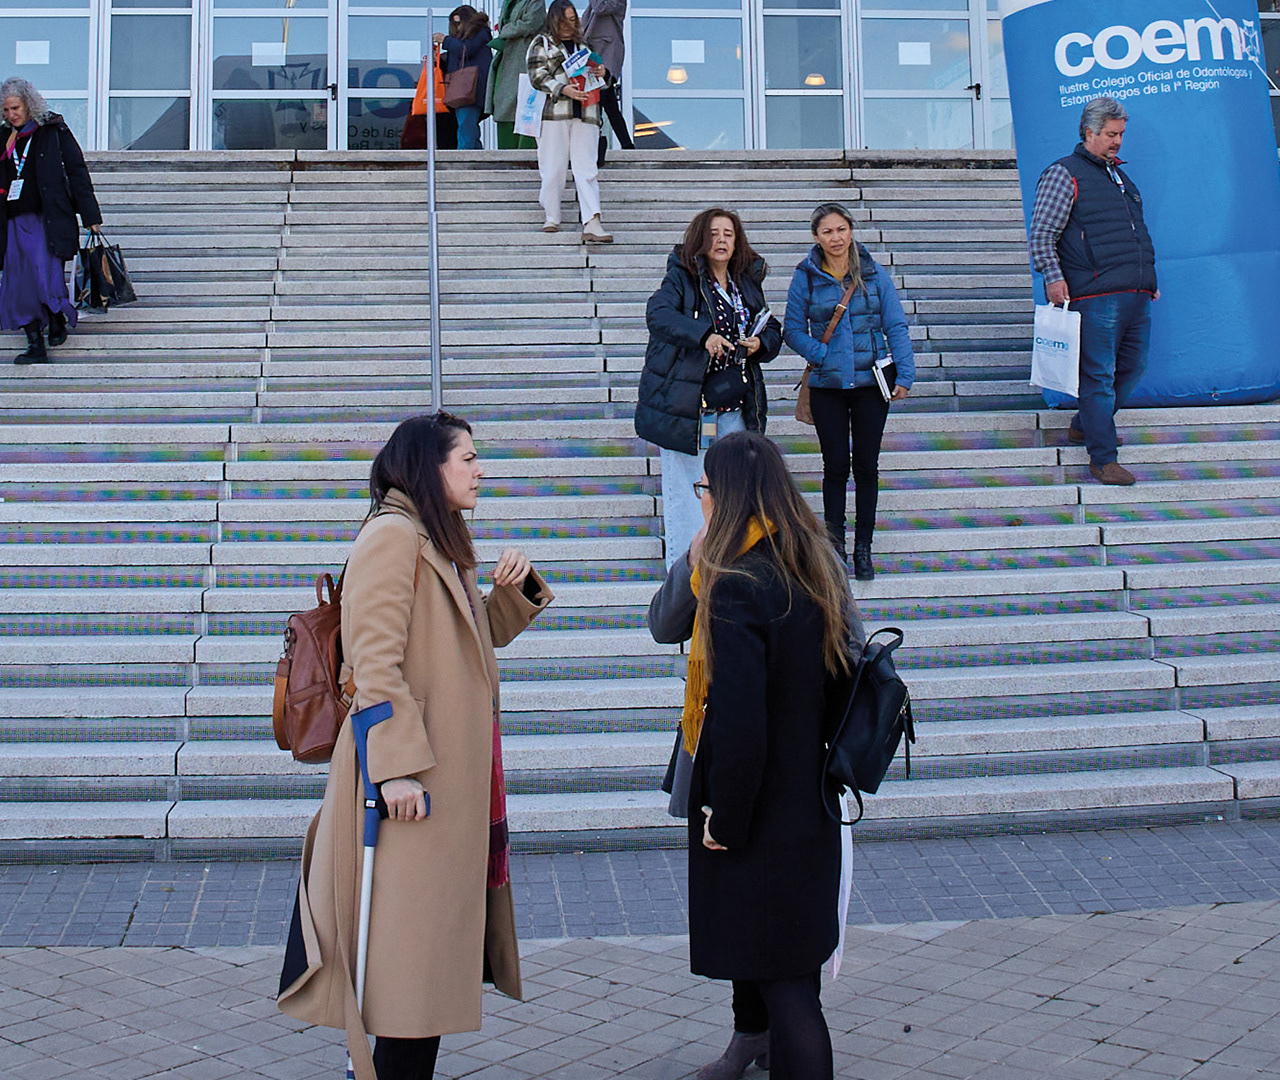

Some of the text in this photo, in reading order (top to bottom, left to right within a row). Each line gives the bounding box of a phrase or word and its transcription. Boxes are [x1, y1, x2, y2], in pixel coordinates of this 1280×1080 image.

[1054, 16, 1243, 77] coem
[1059, 82, 1090, 95] Ilustre
[1092, 75, 1135, 92] Colegio
[1137, 69, 1173, 83] Oficial
[1176, 68, 1190, 79] de
[1192, 66, 1248, 79] Odontólogos
[1143, 83, 1158, 94] de
[1160, 81, 1171, 92] la
[1185, 79, 1220, 93] Región
